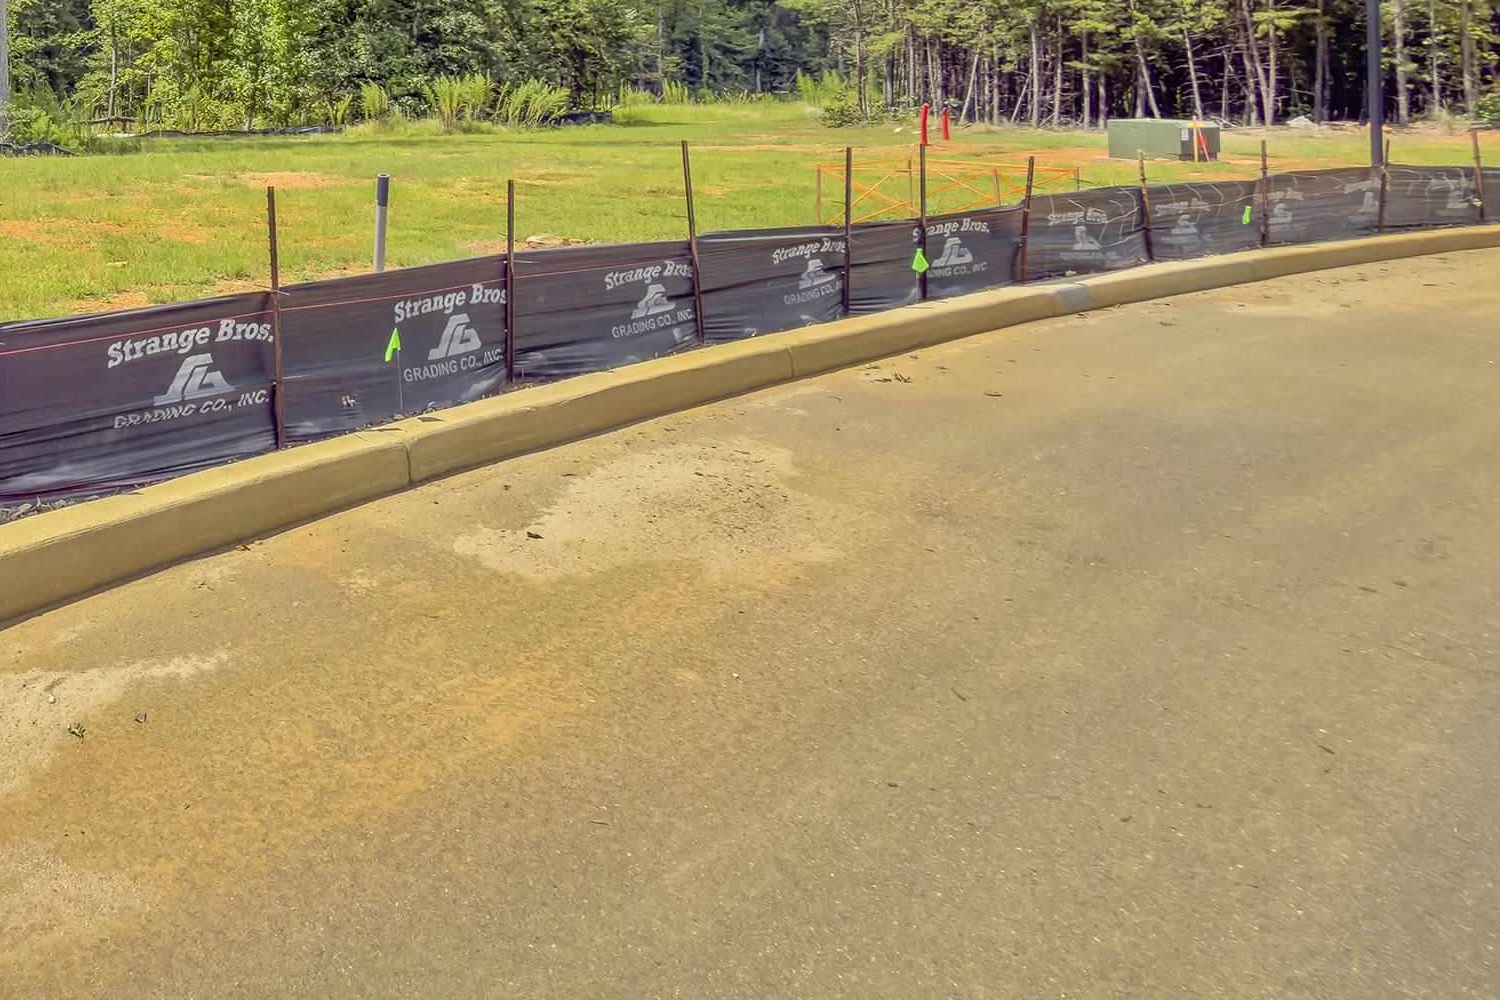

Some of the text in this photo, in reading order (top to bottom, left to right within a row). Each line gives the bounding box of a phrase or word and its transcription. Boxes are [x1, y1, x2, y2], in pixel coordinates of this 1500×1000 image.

[912, 218, 989, 242] Sange Bros.
[772, 242, 820, 264] Strange
[605, 264, 661, 290] Strange
[394, 290, 466, 324] Strange
[612, 318, 656, 338] GRADING
[108, 319, 274, 368] Strange Bros.
[404, 360, 458, 382] GRADING
[239, 390, 269, 407] INC.
